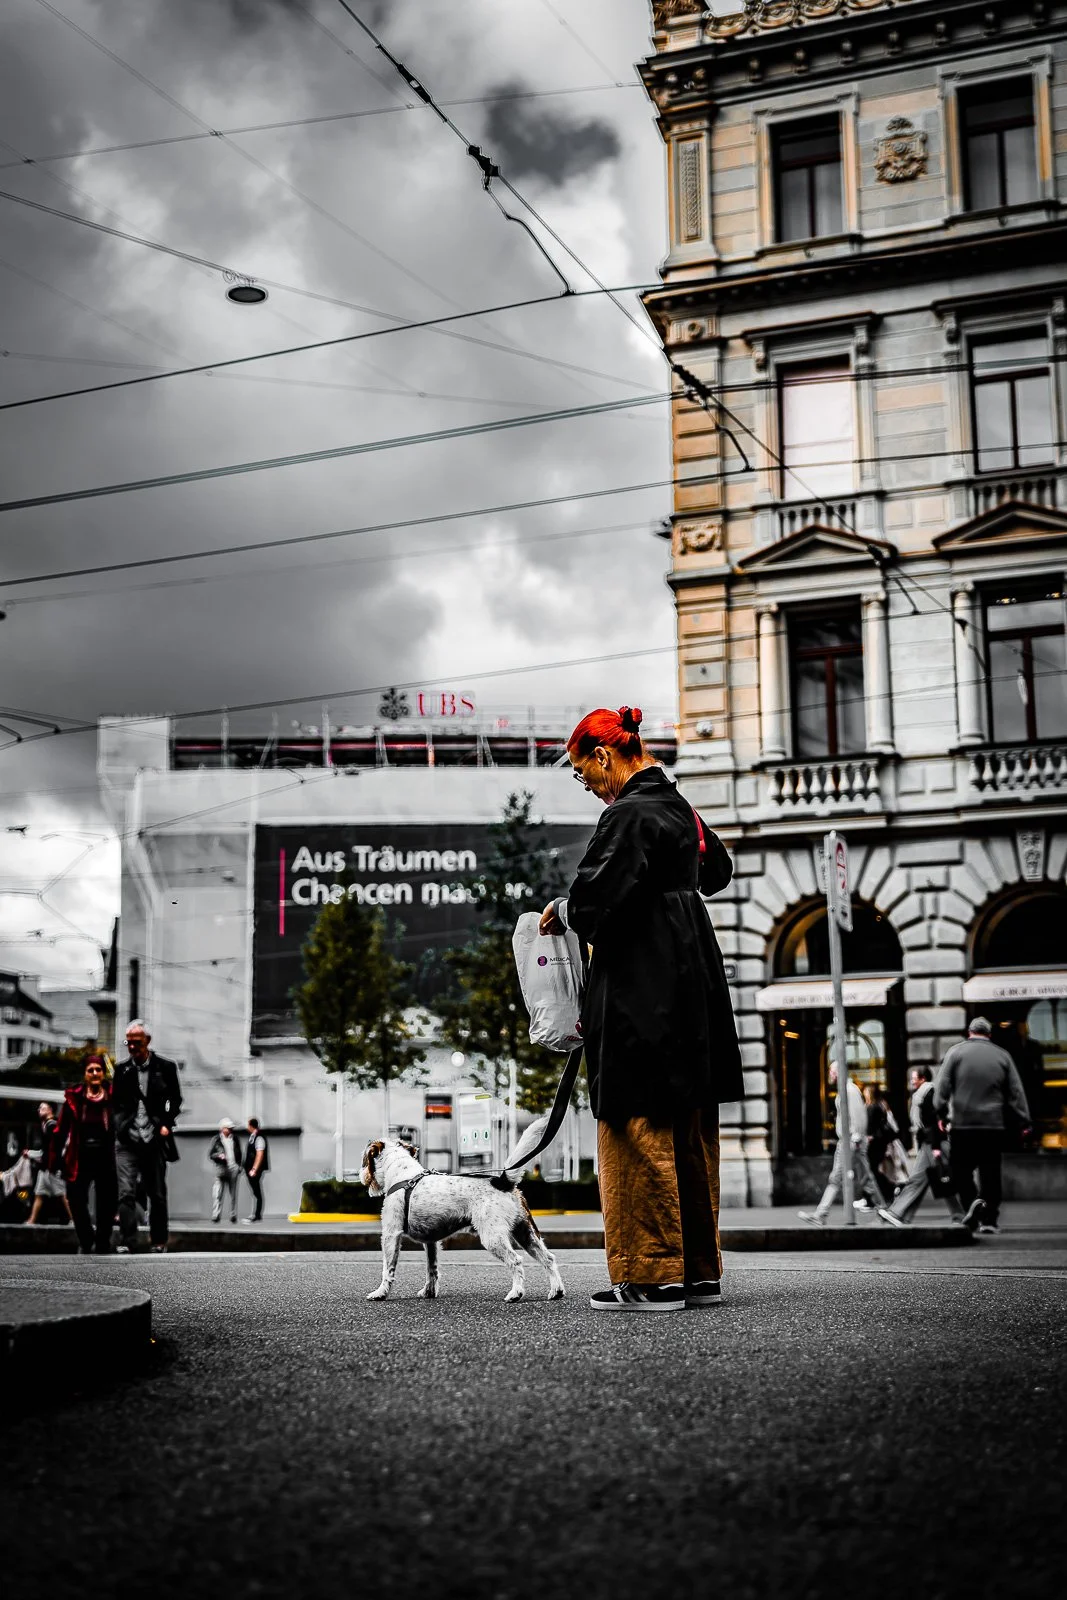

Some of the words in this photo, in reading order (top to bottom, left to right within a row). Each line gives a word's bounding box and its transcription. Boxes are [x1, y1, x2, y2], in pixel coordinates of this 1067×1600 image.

[416, 691, 475, 716] UBS
[291, 846, 346, 873] Aus
[352, 845, 477, 872] Träumen
[292, 877, 413, 905] Chancen
